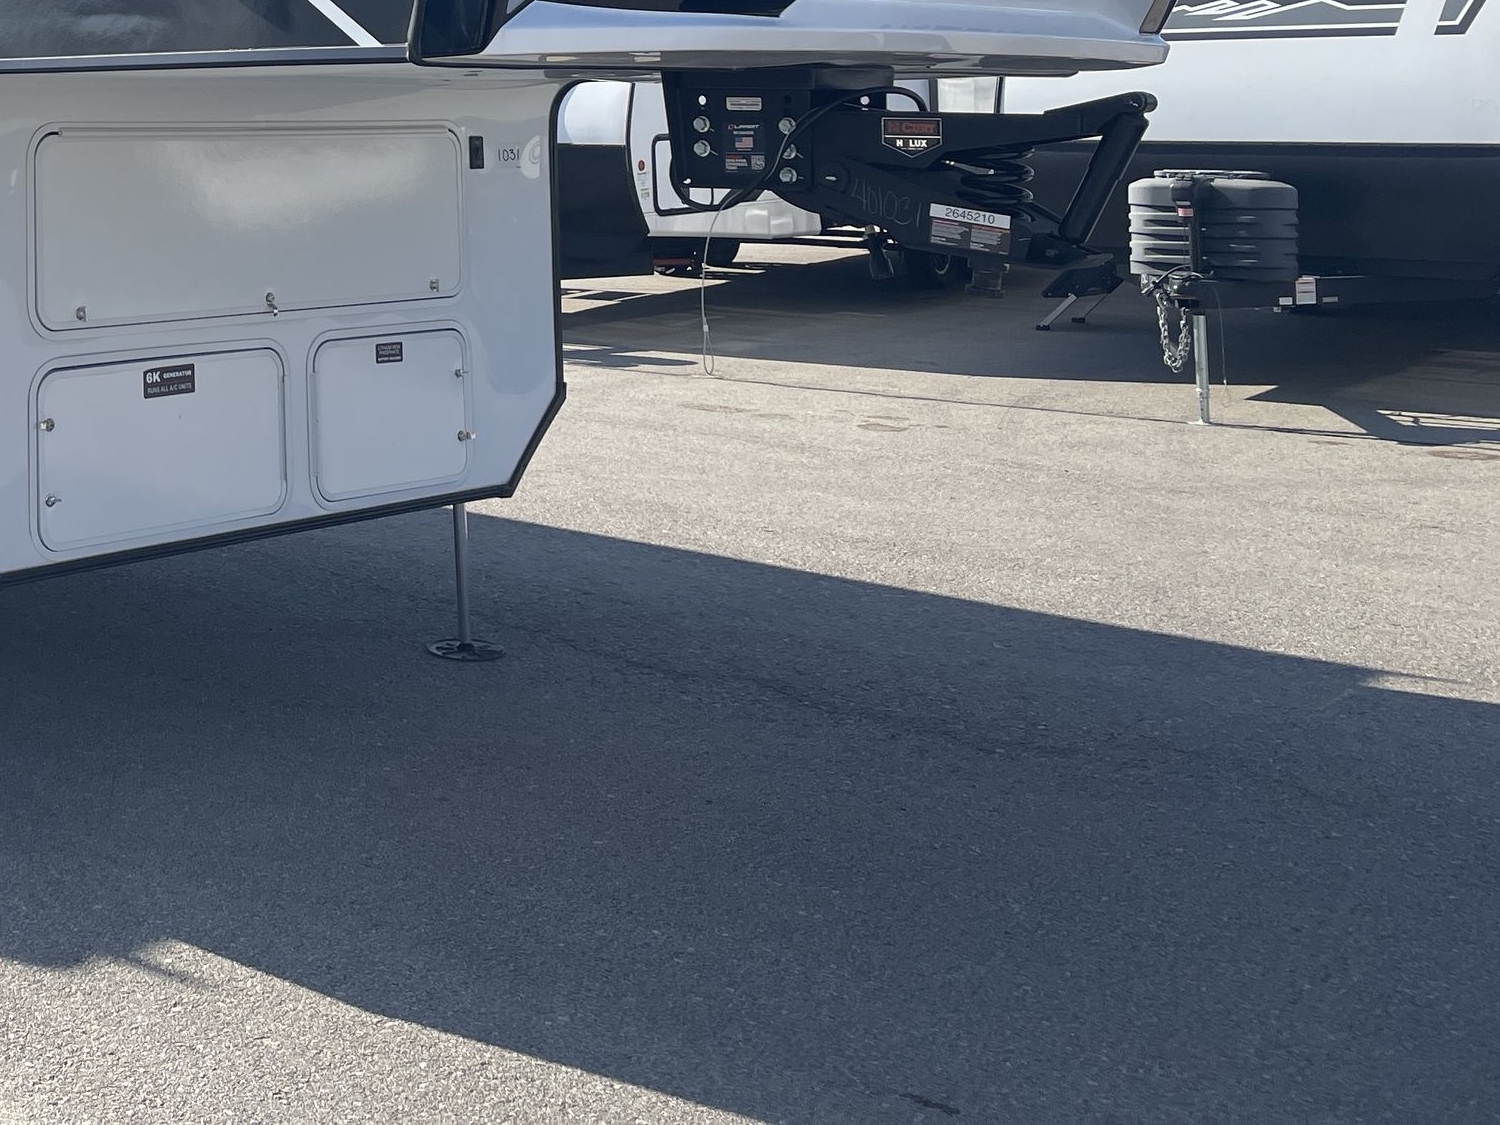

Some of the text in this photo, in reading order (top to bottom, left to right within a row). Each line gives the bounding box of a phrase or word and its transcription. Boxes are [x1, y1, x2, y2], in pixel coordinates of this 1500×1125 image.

[497, 147, 520, 162] 1031
[944, 207, 996, 225] 2645210
[145, 369, 192, 384] 6K GENERATOR
